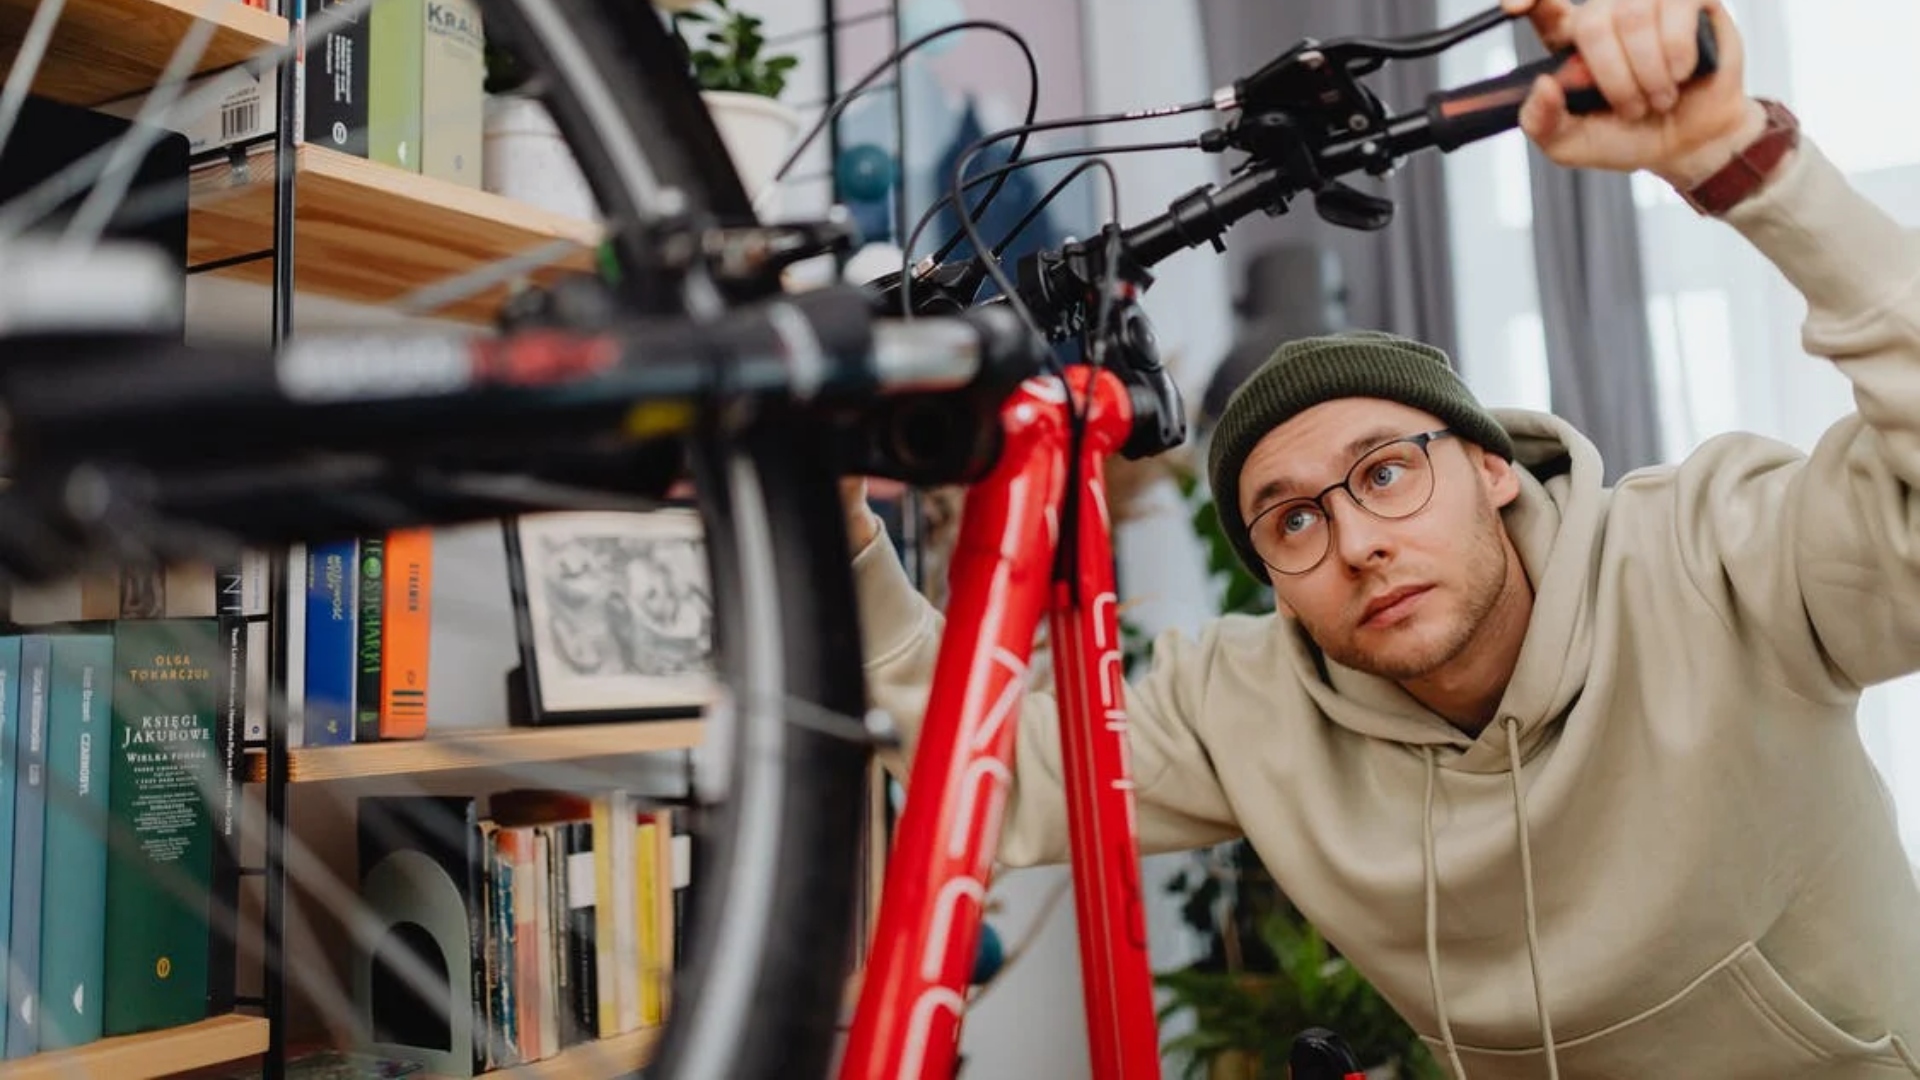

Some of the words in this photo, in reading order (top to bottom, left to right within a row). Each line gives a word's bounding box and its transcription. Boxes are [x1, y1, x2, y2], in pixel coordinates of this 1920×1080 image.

[154, 654, 191, 666] OLGA
[142, 714, 198, 729] KSIĘGI
[122, 727, 210, 748] JAKUBOWE
